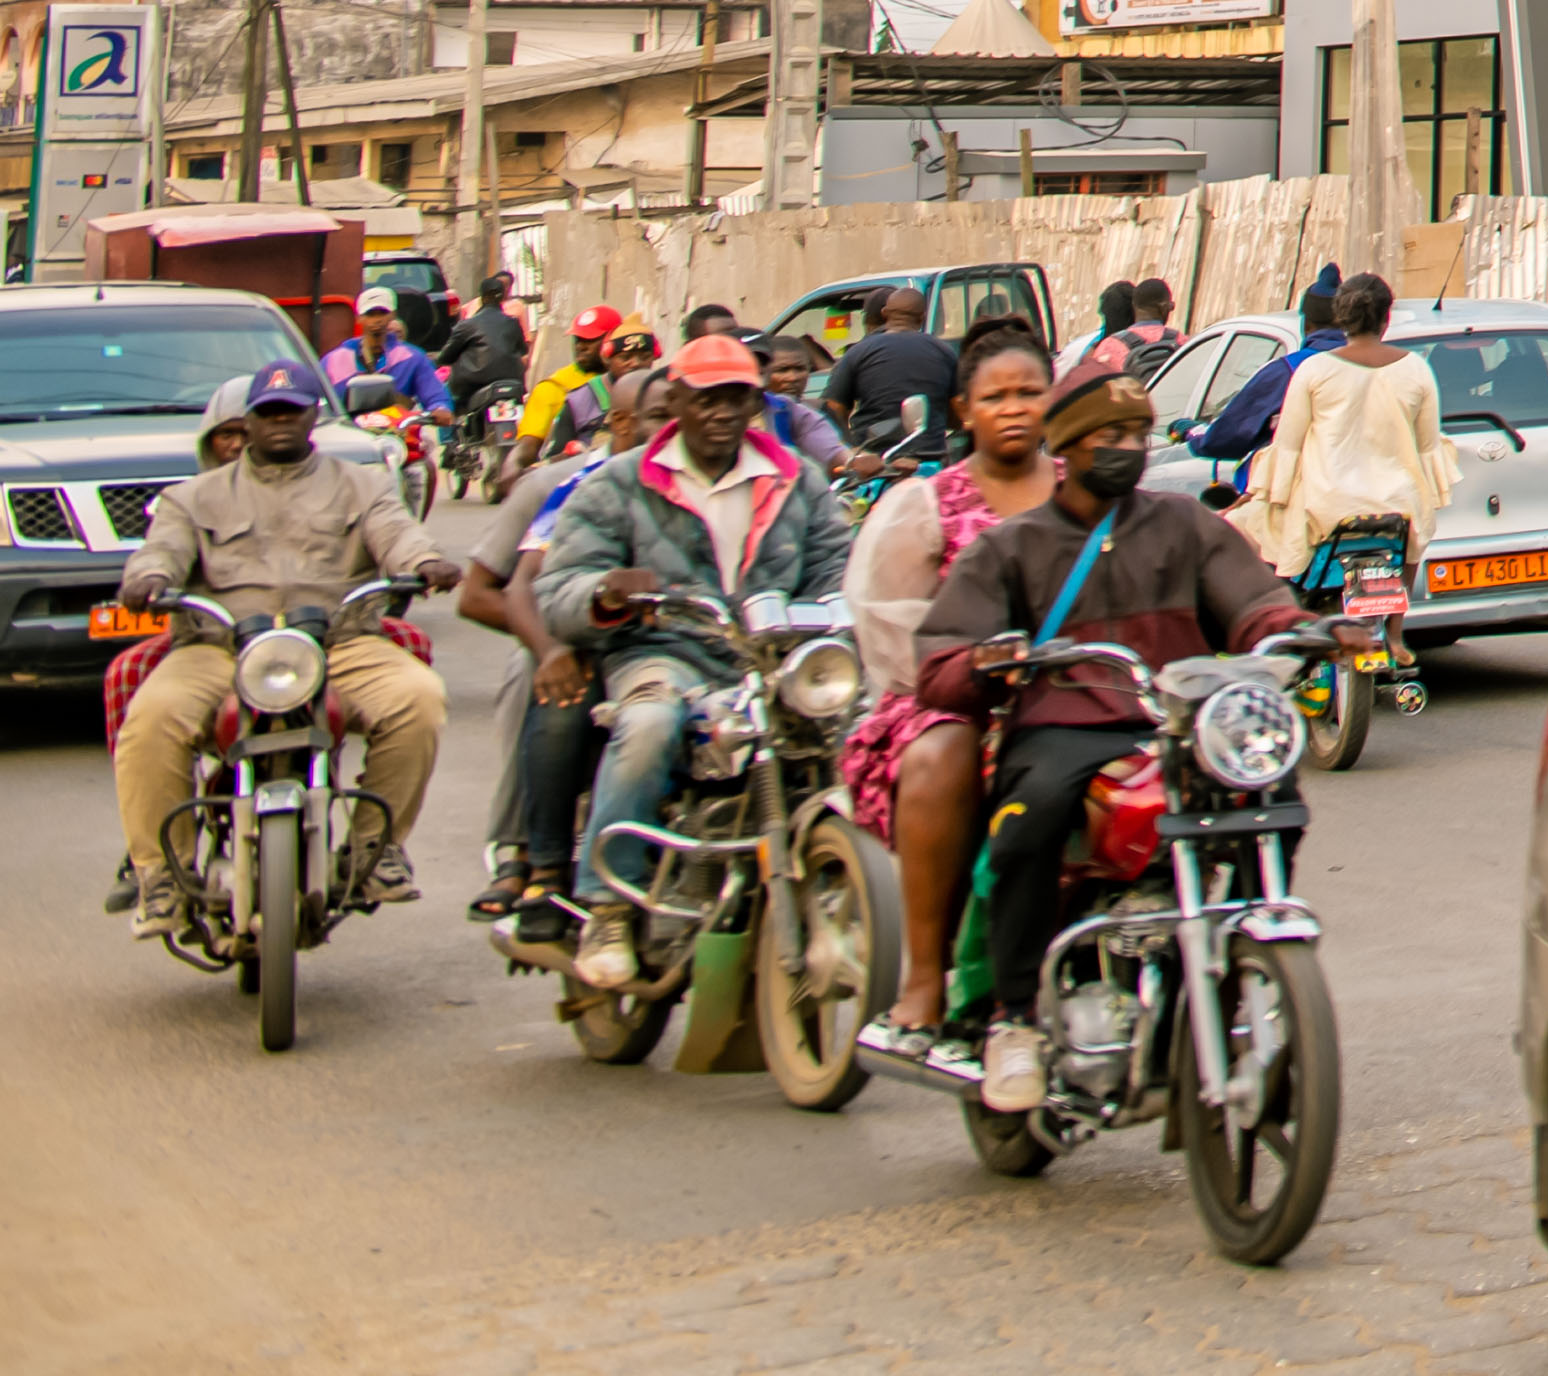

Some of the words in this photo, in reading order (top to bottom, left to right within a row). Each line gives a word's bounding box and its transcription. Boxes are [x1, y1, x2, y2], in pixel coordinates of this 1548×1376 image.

[1453, 561, 1475, 586] LT
[1485, 557, 1518, 582] 430
[1525, 554, 1547, 578] LI
